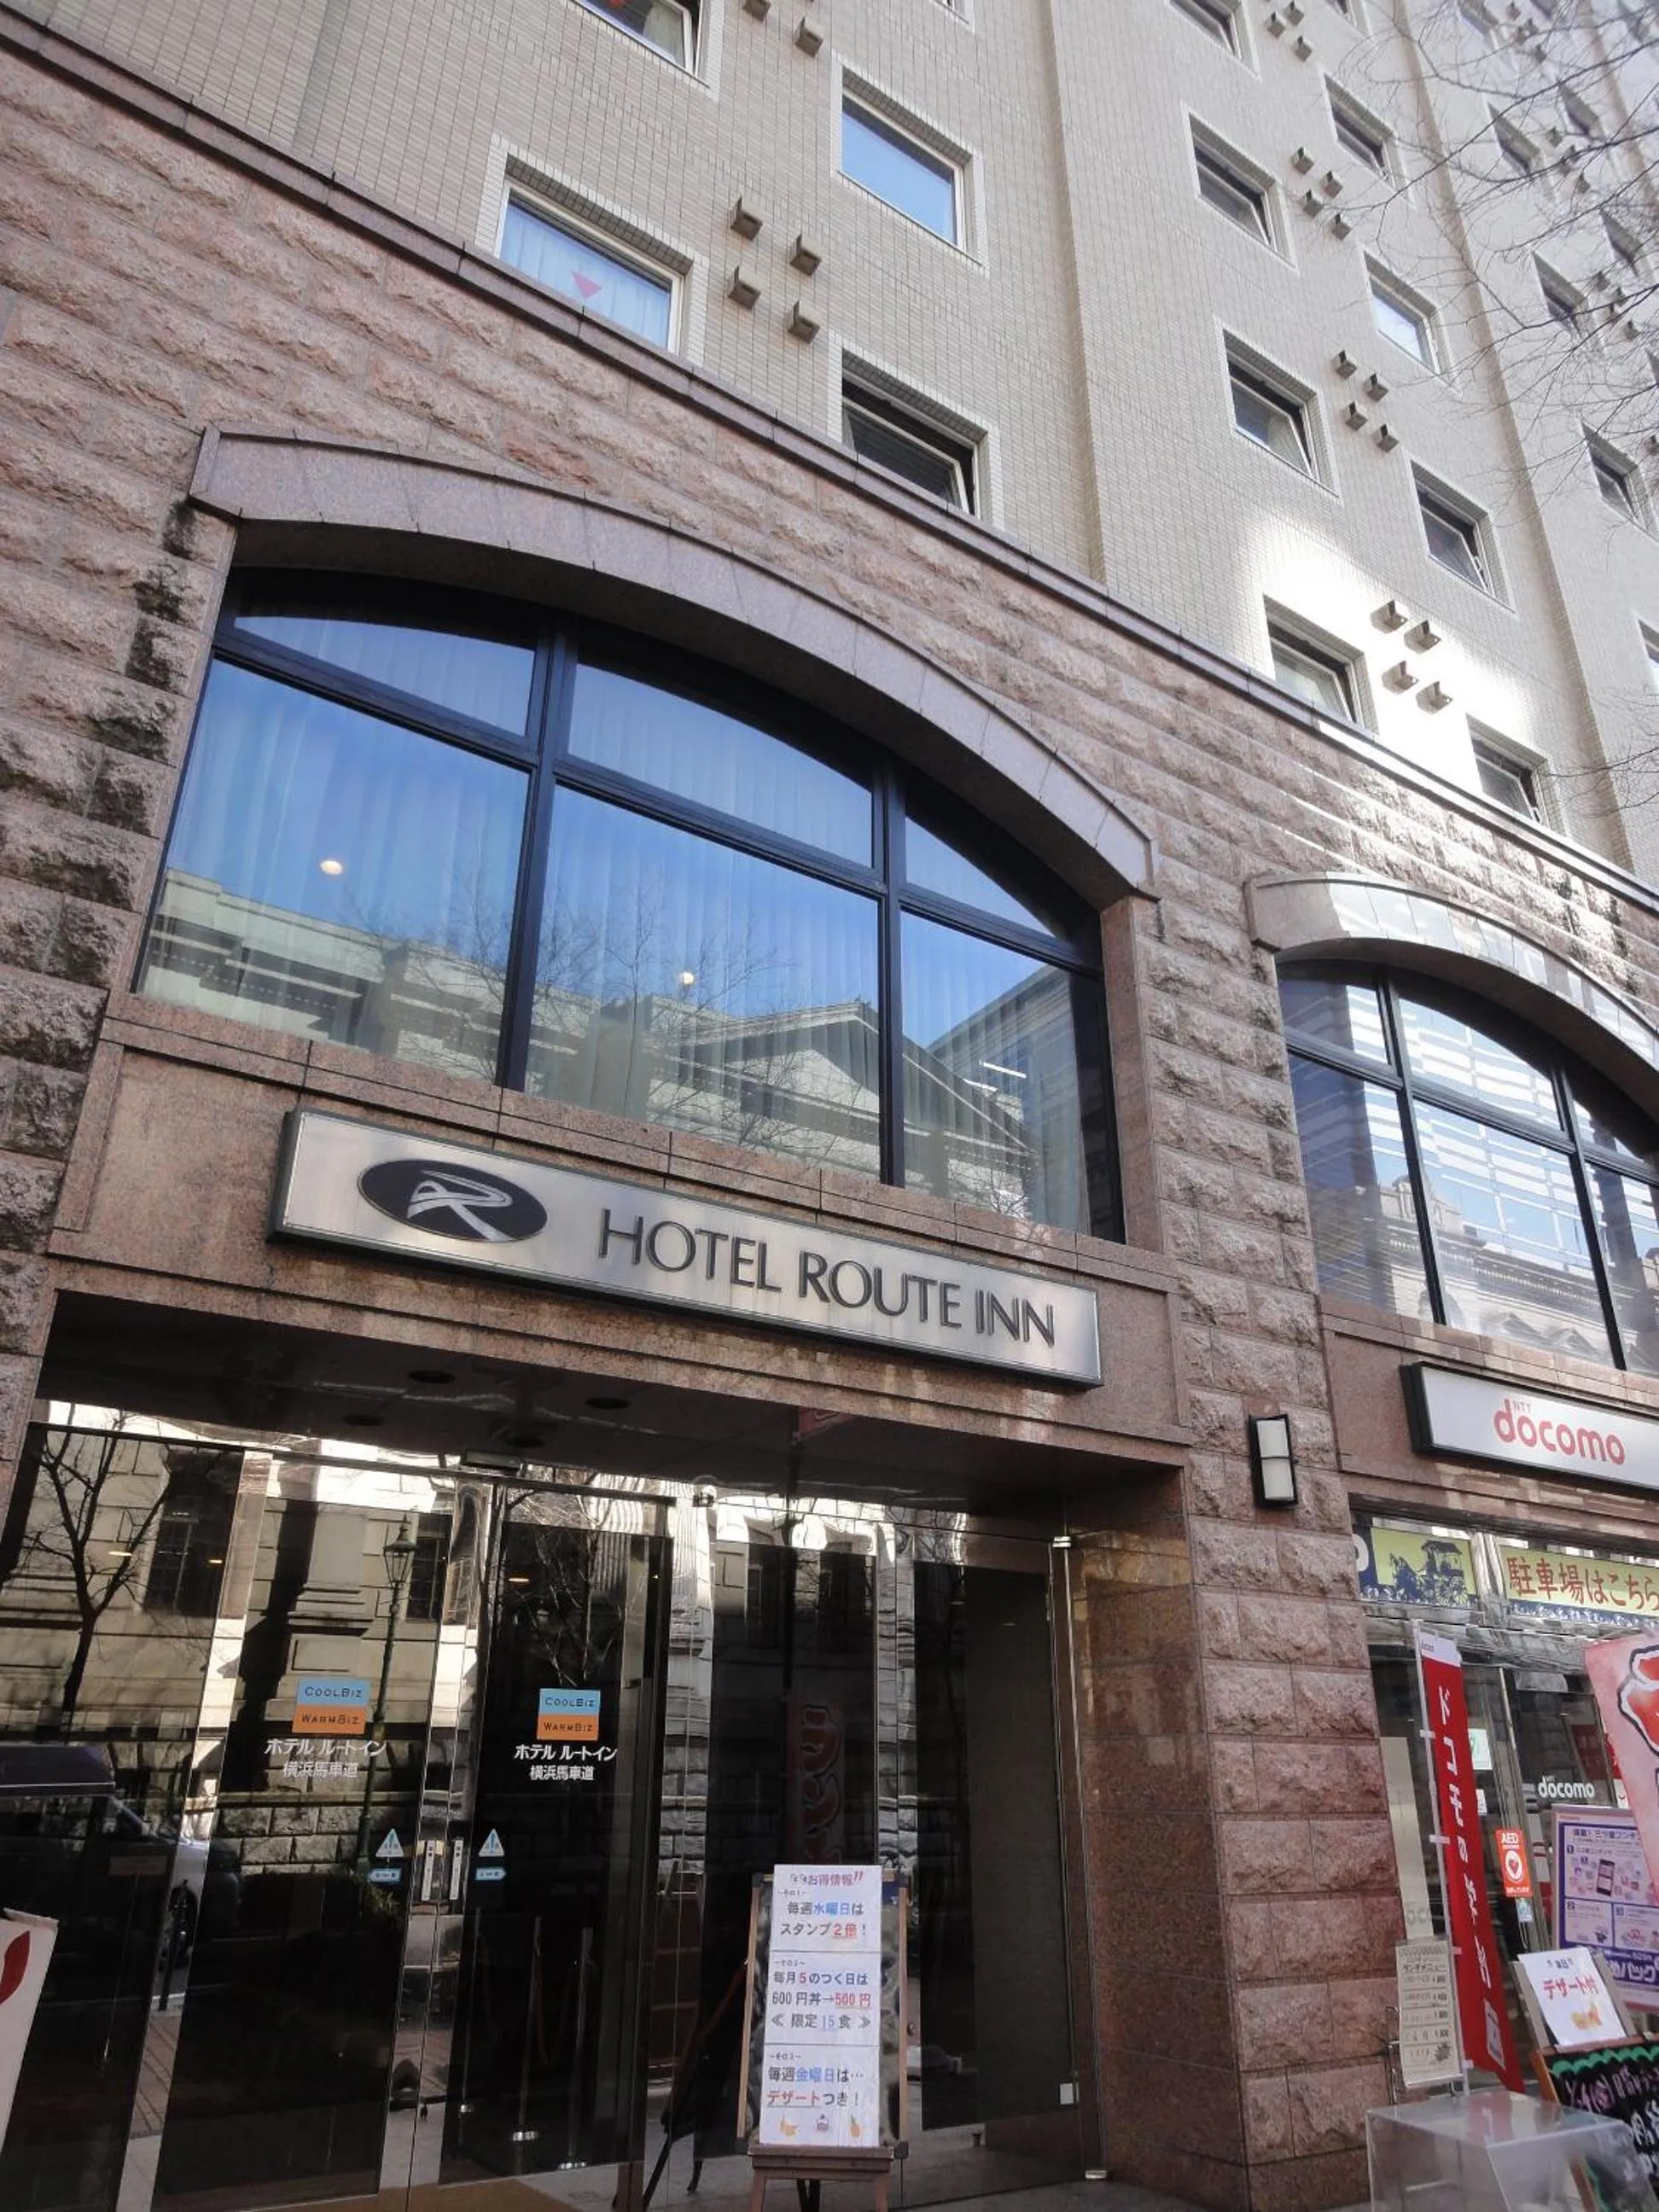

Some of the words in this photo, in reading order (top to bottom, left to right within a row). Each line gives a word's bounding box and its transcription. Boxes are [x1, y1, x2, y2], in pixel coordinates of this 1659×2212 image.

[599, 1208, 782, 1294] HOTEL
[798, 1250, 962, 1330] ROUTE
[975, 1289, 1056, 1348] INN
[1512, 1400, 1532, 1414] NTT
[1493, 1398, 1626, 1465] docomo
[1506, 1556, 1659, 1611] 駐車場はこちら
[282, 1761, 358, 1778] 横浜馬車道
[530, 1765, 595, 1781] 横浜馬車道
[1538, 1775, 1594, 1798] docomo
[1502, 1832, 1518, 1843] AED
[786, 1901, 864, 1916] 毎週水曜日は
